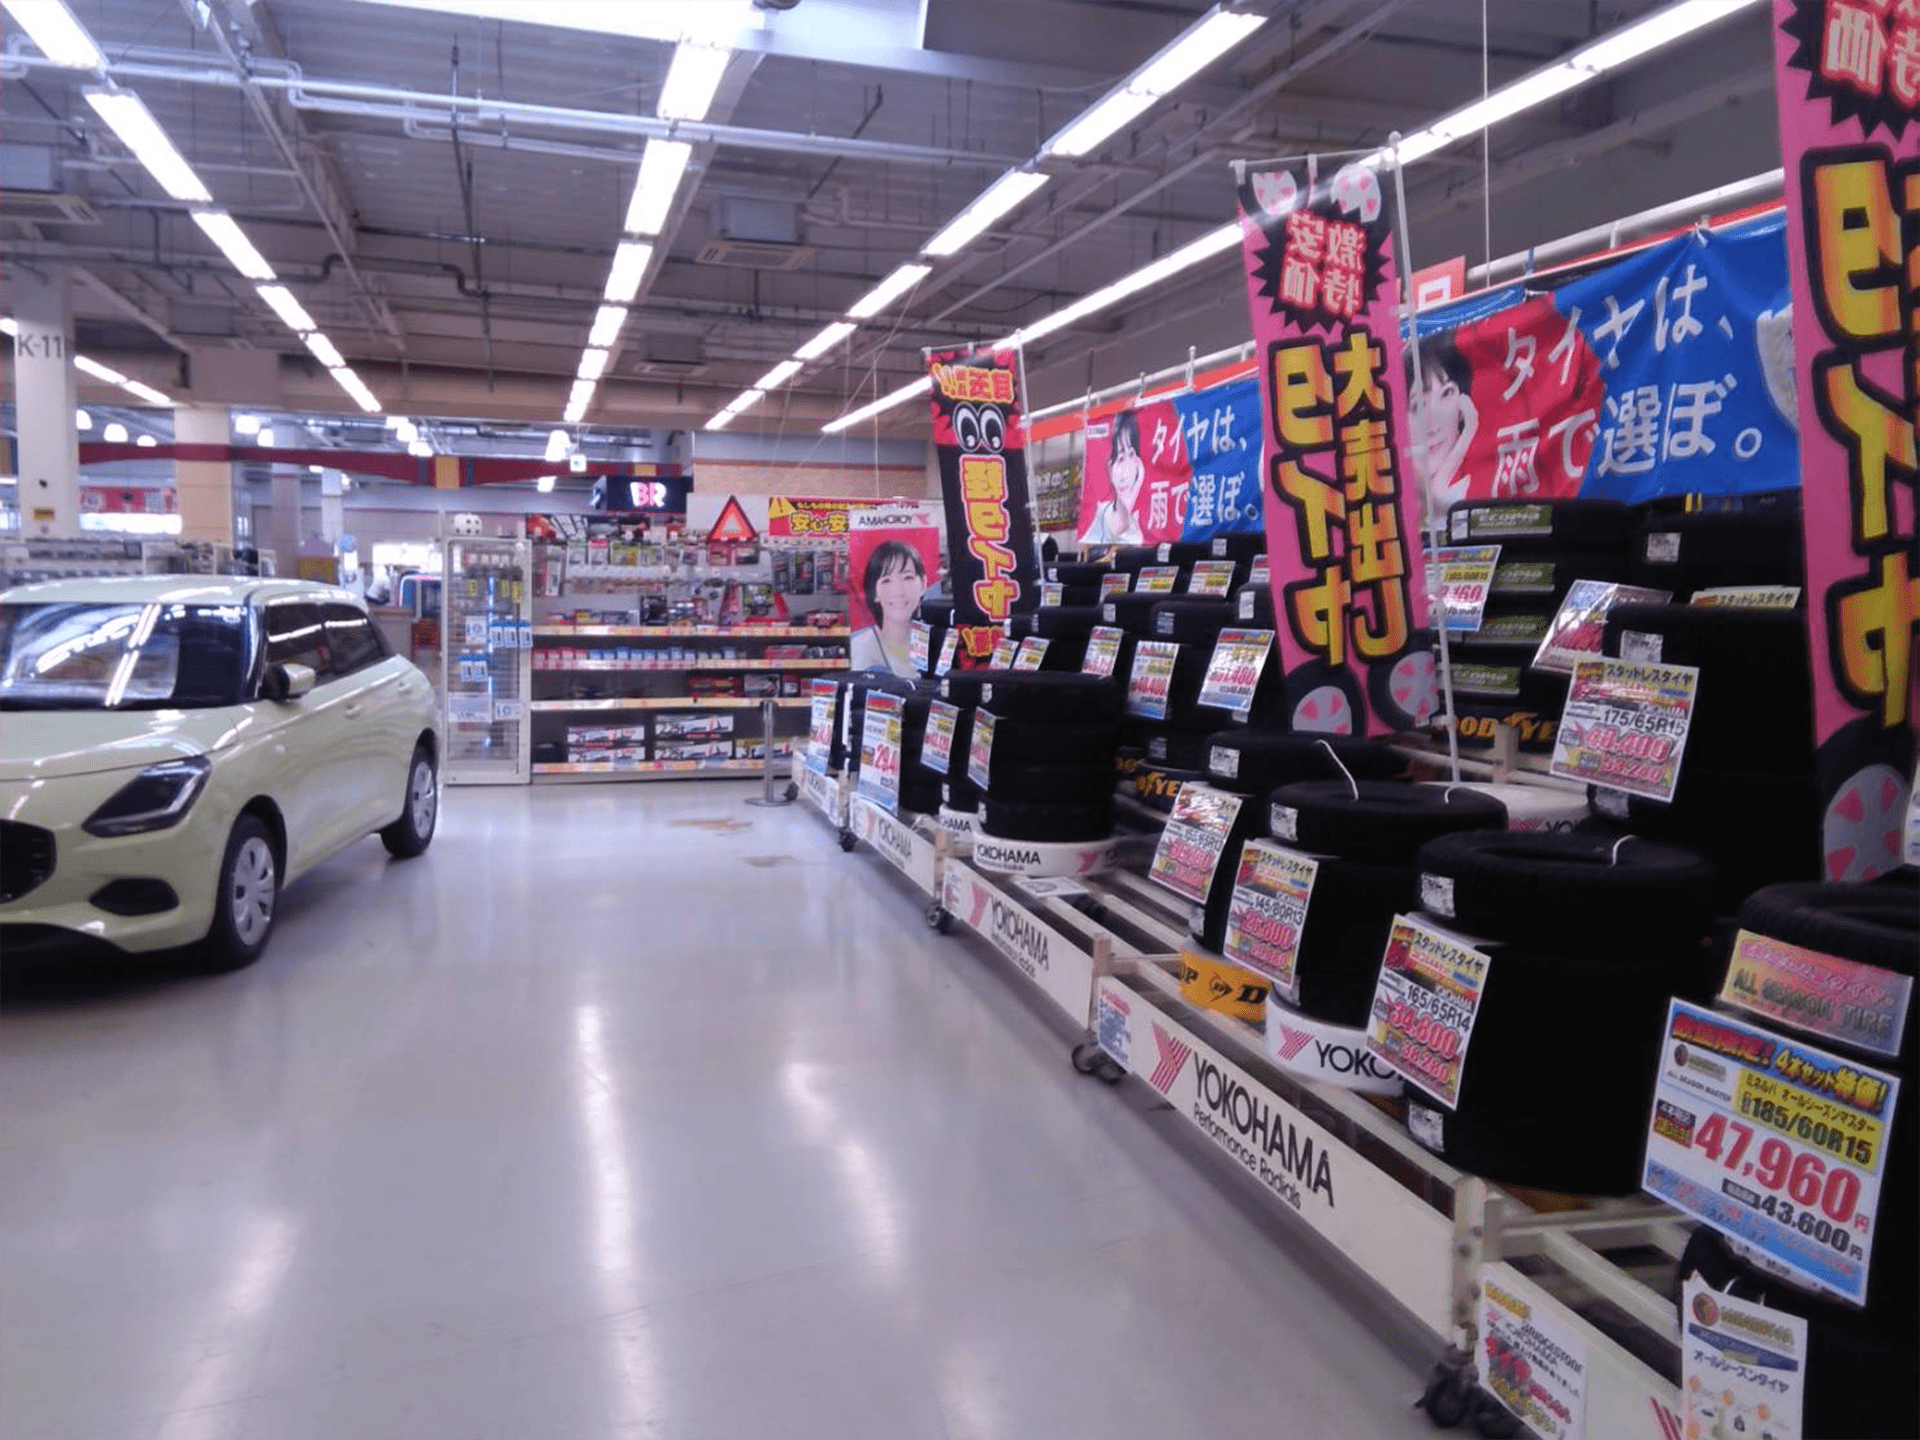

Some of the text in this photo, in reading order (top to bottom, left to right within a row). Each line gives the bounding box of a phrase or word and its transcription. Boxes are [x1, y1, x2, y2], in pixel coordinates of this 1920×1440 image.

[17, 334, 63, 358] K-11
[1503, 264, 1734, 400] タイヤは、
[1151, 405, 1248, 464] タイヤは、
[1492, 374, 1762, 499] 雨で選ぼ。
[1147, 471, 1259, 530] 雨で選ぼ。
[1605, 663, 1694, 686] スタッドレスタイヤ
[1603, 709, 1687, 738] 175/65R15
[990, 895, 1050, 971] YOKOHAMA
[1413, 932, 1485, 976] スタッドレスタイヤ
[1407, 983, 1472, 1032] 165/65R14
[1193, 1051, 1335, 1208] YOKOHAMA
[1193, 1102, 1302, 1210] Performance Radials
